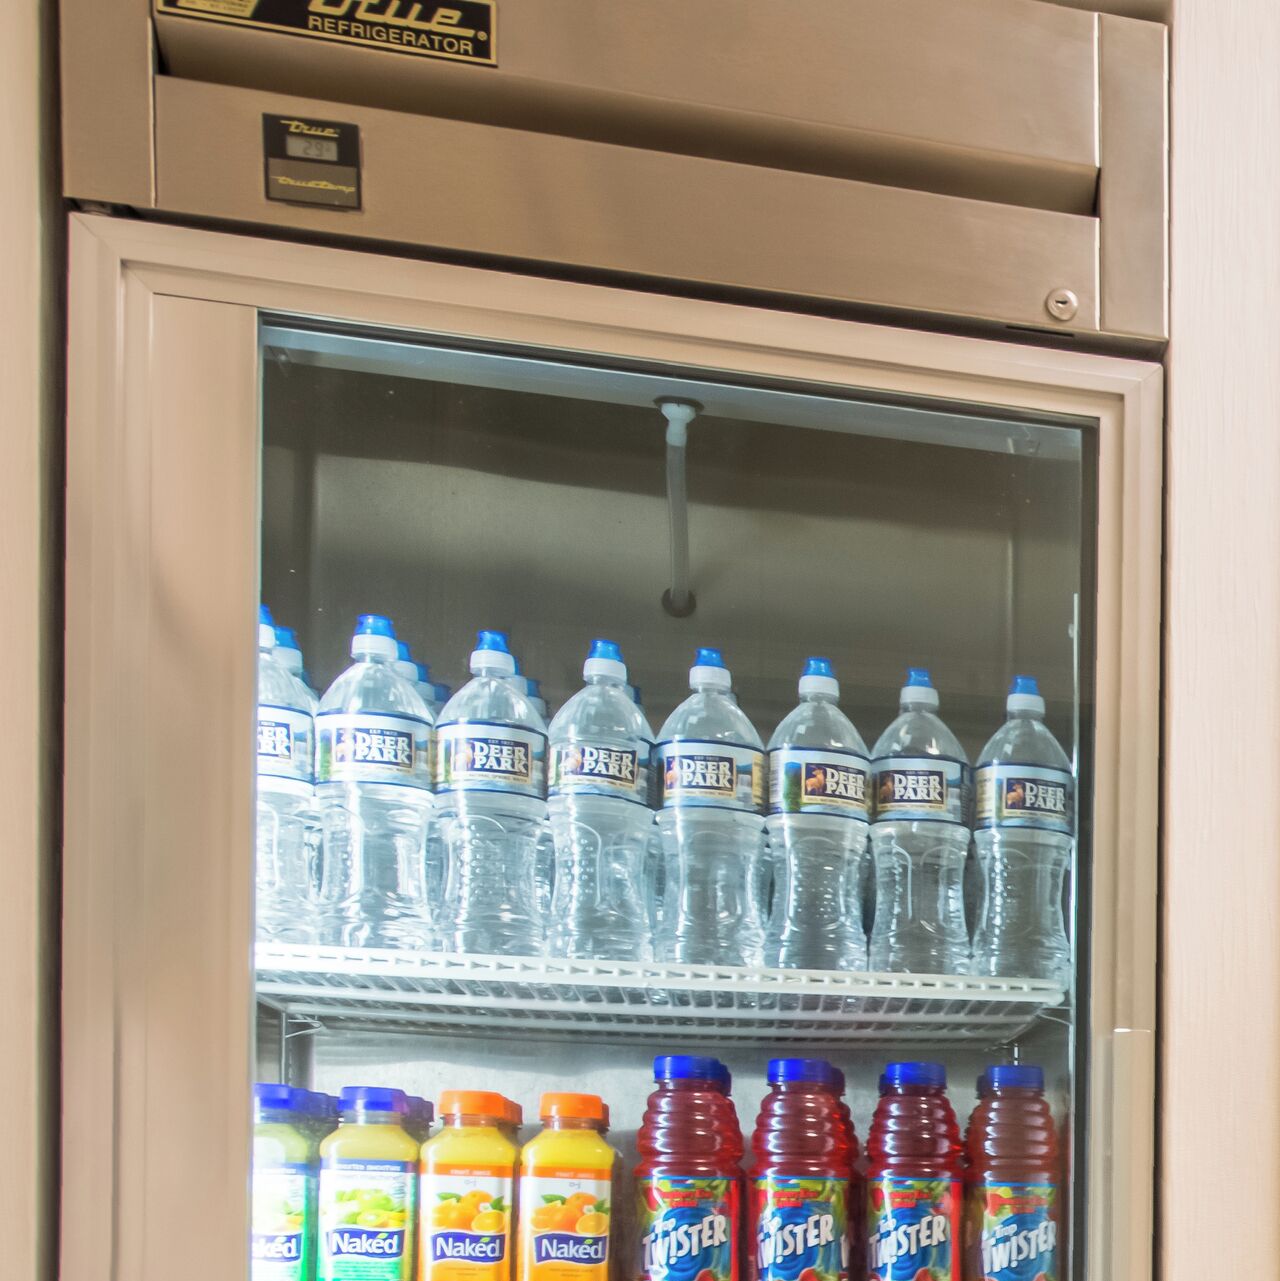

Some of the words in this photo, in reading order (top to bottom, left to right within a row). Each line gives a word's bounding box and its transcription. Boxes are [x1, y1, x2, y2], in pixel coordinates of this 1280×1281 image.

[308, 15, 473, 55] REFRIGERATOR
[354, 732, 410, 751] DEER
[474, 741, 527, 760] DEER
[354, 747, 411, 764] PARK
[474, 755, 528, 774] PARK
[583, 746, 632, 766] DEER
[583, 760, 635, 780] PARK
[682, 758, 732, 776] DEER
[682, 774, 734, 788] PARK
[826, 768, 864, 787] DEER
[894, 773, 942, 788] DEER
[826, 782, 864, 800] PARK
[894, 787, 943, 801] PARK
[1026, 782, 1065, 798] DEER
[1025, 794, 1066, 812] PARK
[253, 1236, 299, 1258] ked
[332, 1233, 401, 1254] Naked
[436, 1236, 501, 1258] Naked
[541, 1238, 604, 1259] Naked
